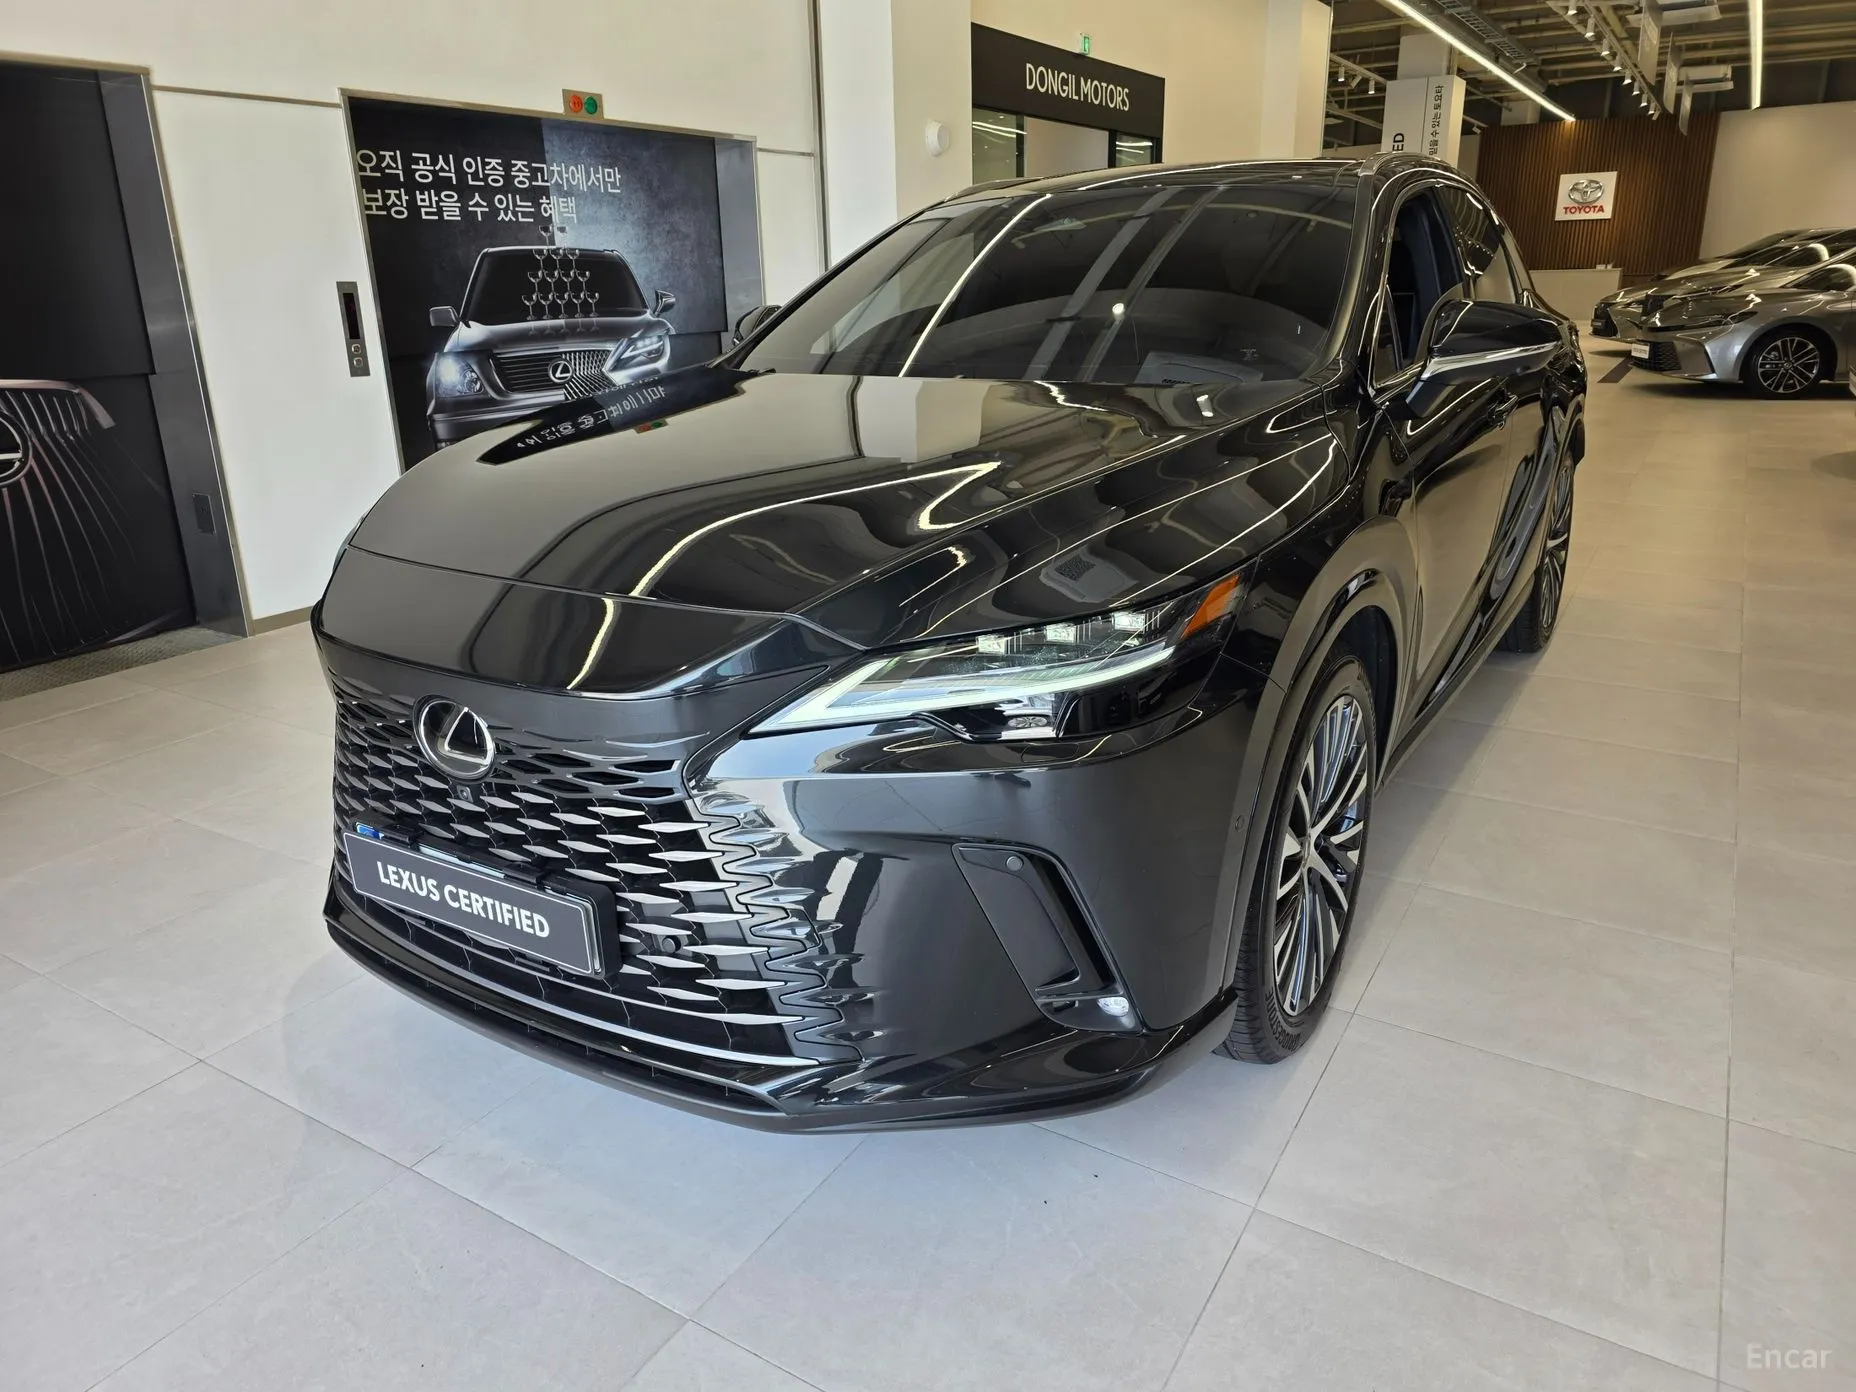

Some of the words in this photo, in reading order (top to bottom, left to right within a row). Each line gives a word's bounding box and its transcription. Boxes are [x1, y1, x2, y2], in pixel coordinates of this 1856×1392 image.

[1026, 63, 1079, 100] DONGIL
[1080, 76, 1130, 111] MOTORS
[1433, 85, 1444, 111] 토요타
[1430, 129, 1440, 138] 수
[1431, 112, 1442, 129] 있는
[356, 149, 404, 182] 오직
[411, 152, 457, 185] 공식
[462, 156, 505, 187] 인증
[510, 160, 621, 193] 중고차에서만
[362, 188, 409, 219] 보장
[415, 189, 461, 220] 받을
[468, 192, 489, 221] 수
[494, 193, 535, 222] 있는
[539, 196, 577, 223] 혜택
[1563, 205, 1605, 215] TOYOTA
[377, 861, 440, 902] LEXUS
[444, 884, 550, 938] CERTIFIED
